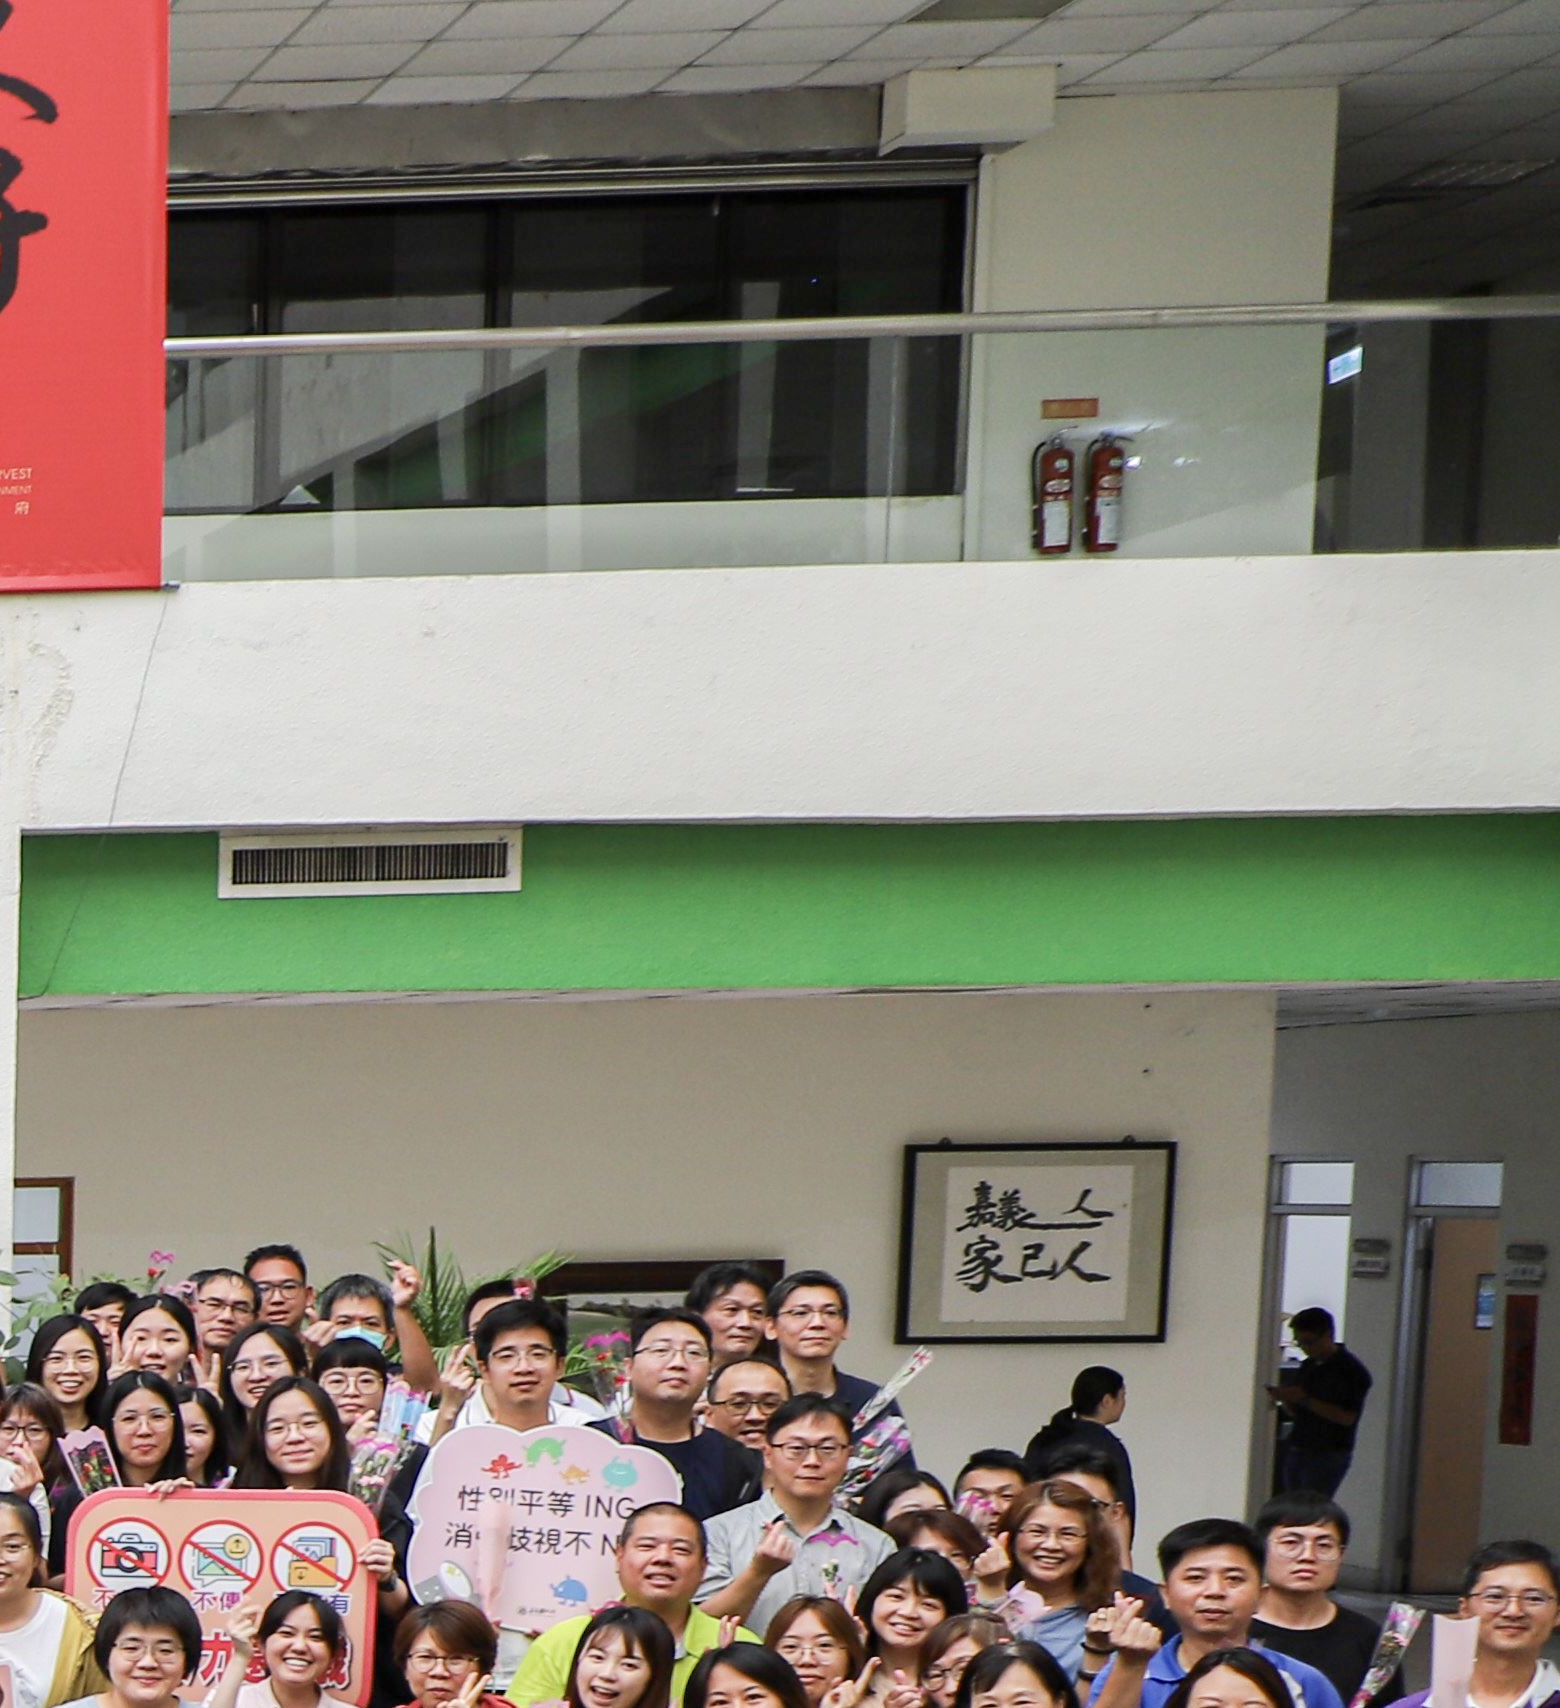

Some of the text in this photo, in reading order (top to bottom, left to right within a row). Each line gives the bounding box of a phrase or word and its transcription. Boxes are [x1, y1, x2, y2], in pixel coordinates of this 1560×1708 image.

[585, 1494, 636, 1520] ING
[445, 1522, 592, 1556] 消歧視不
